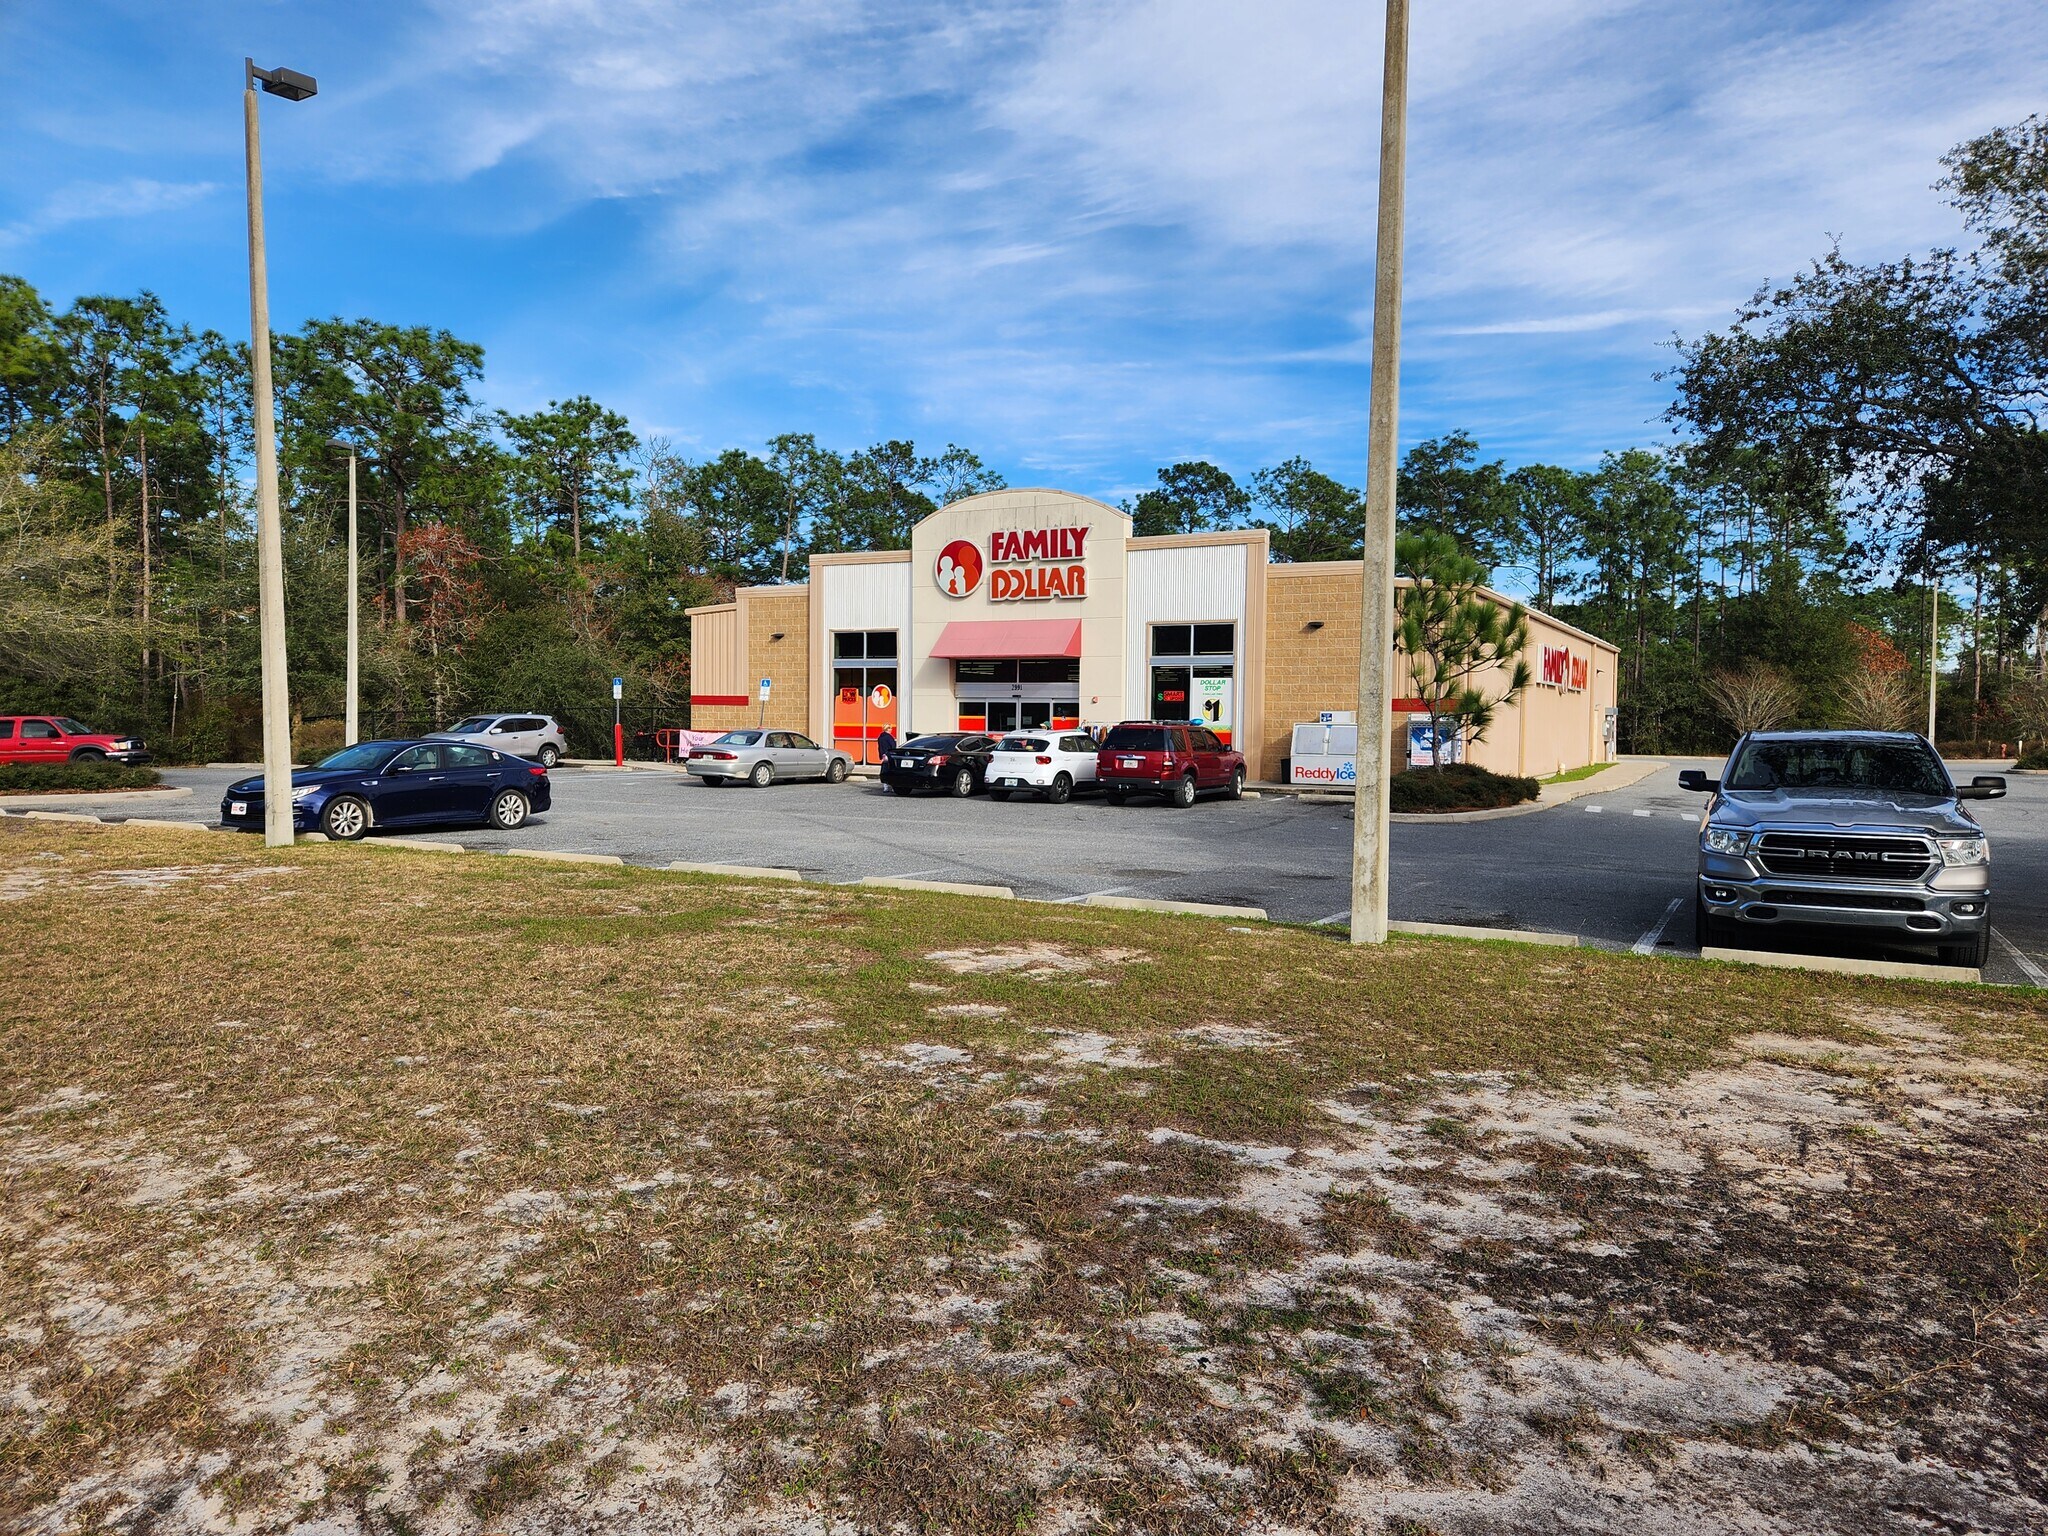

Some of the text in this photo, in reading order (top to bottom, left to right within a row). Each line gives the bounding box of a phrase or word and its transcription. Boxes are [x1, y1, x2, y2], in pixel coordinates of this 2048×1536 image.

[991, 526, 1090, 561] FAMILY
[991, 565, 1086, 599] DOLLAR
[1807, 849, 1878, 860] RAM
